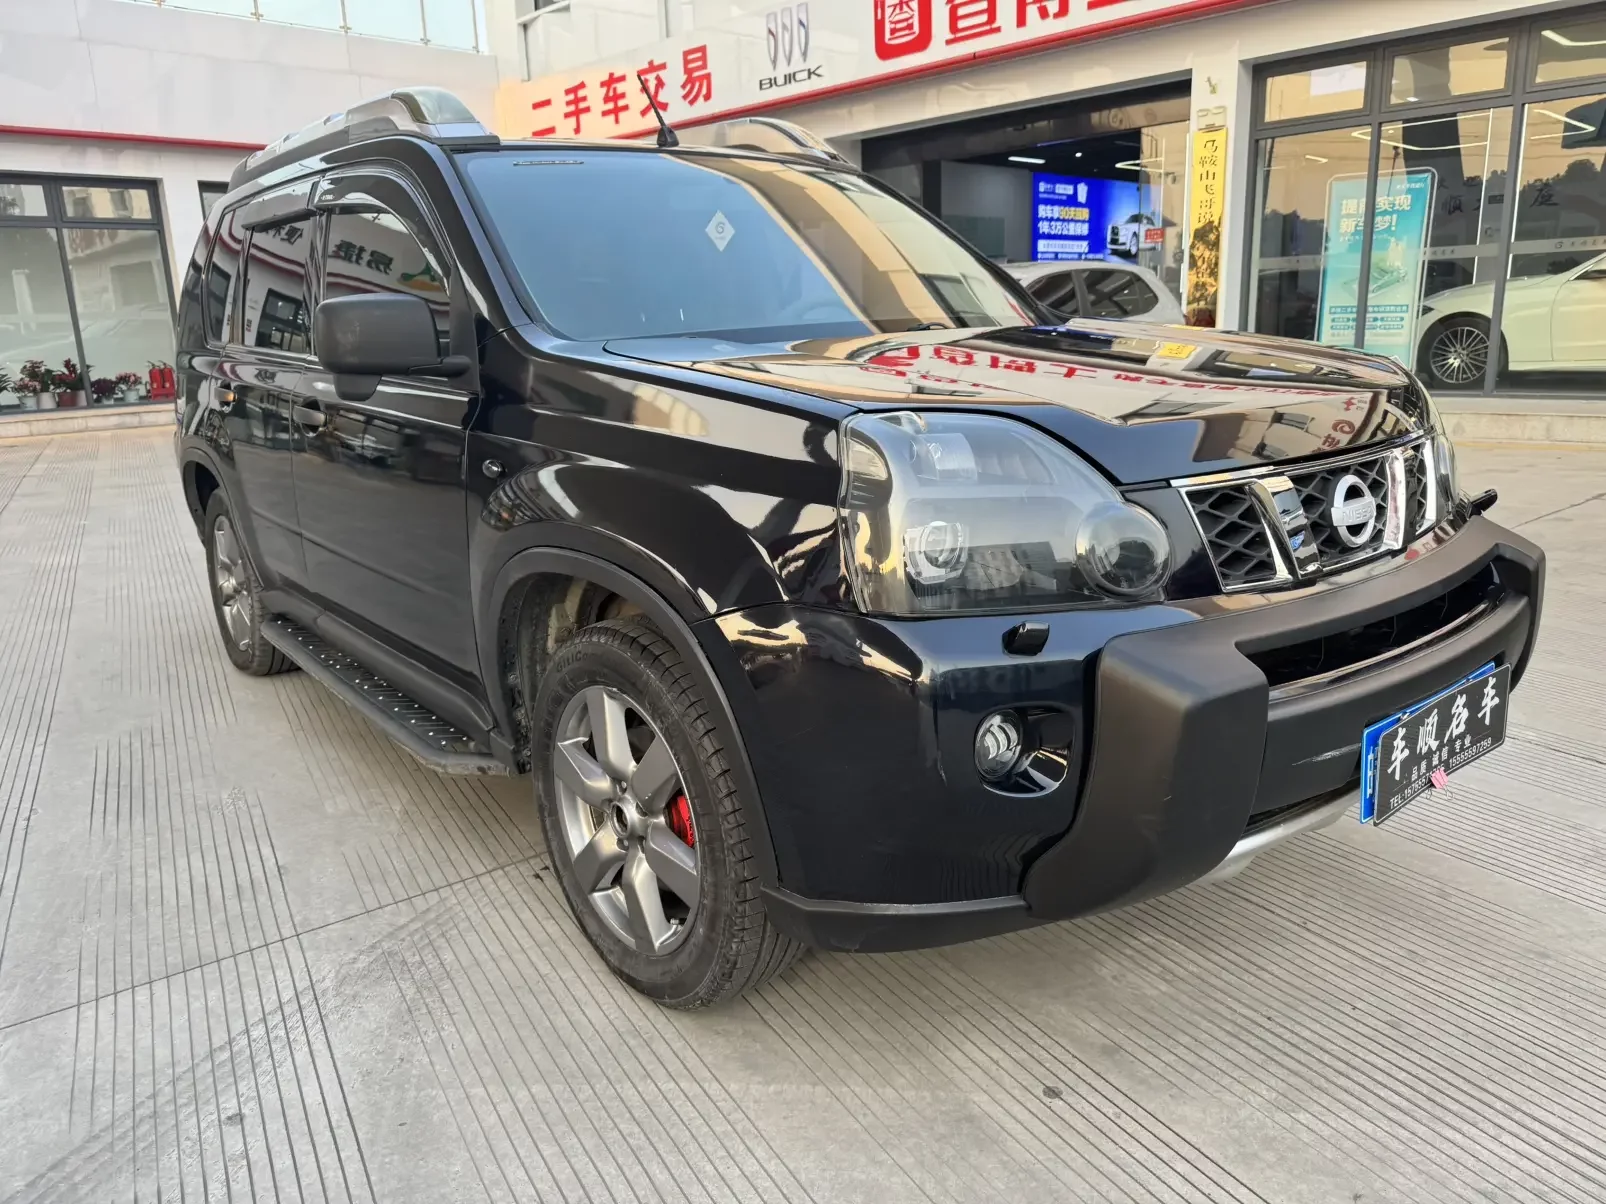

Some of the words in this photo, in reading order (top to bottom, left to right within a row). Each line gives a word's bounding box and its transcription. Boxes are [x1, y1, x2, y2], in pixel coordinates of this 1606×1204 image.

[531, 44, 713, 138] 二手车交易
[758, 65, 825, 92] BUICK
